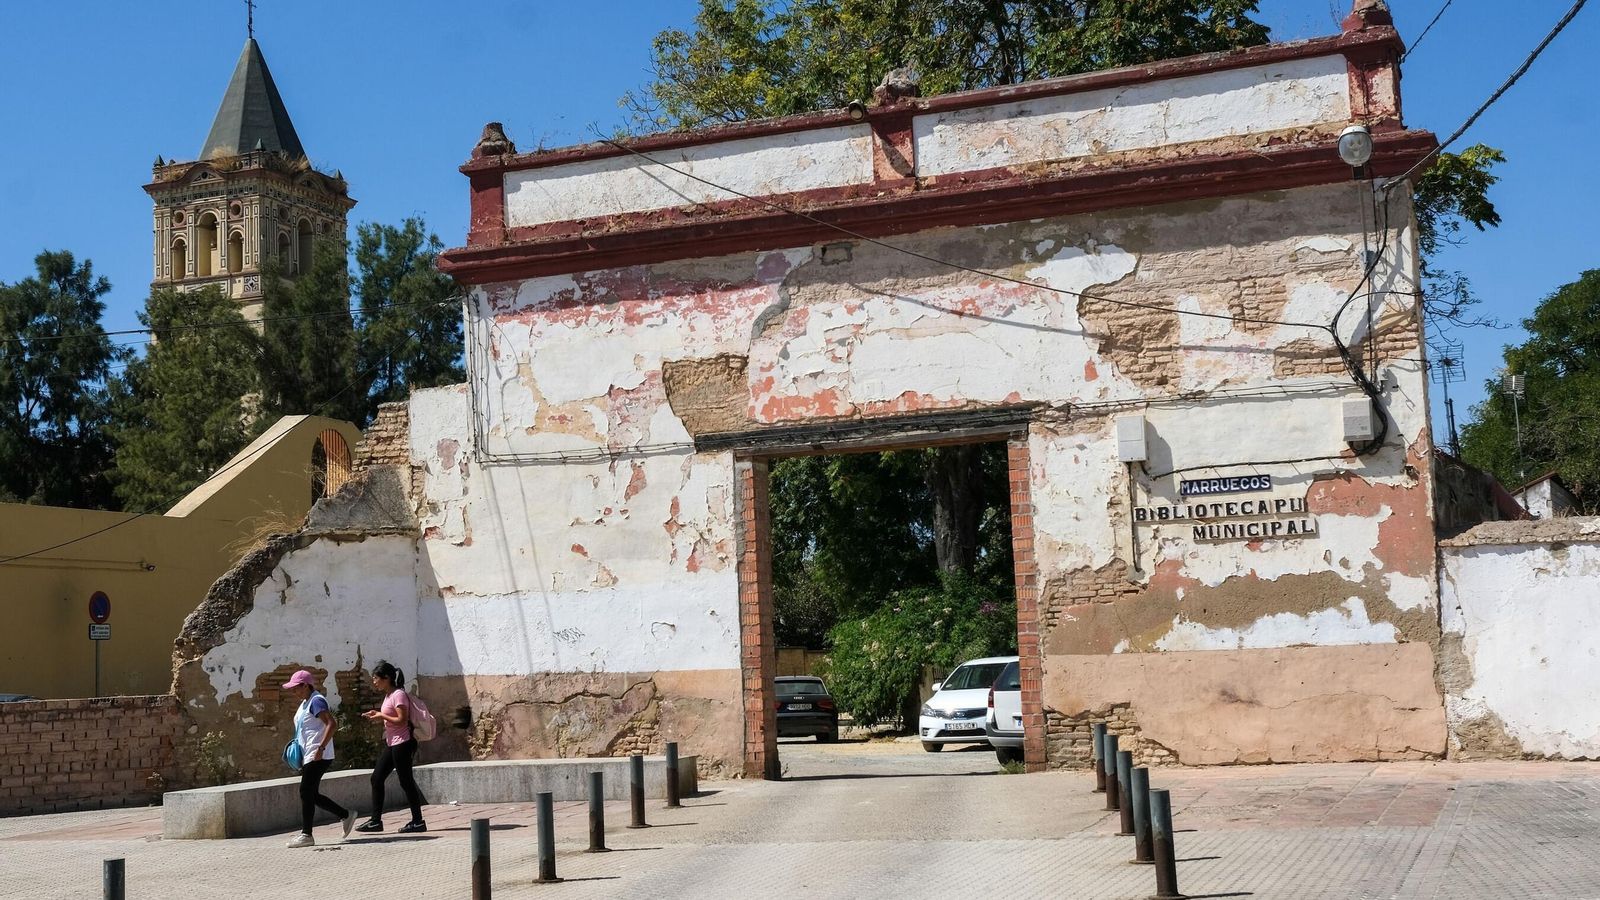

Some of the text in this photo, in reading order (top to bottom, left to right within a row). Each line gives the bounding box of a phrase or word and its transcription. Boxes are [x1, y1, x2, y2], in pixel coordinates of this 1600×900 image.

[1181, 476, 1270, 495] MARRUECOS
[1135, 500, 1269, 521] BIBLIOTECA
[1193, 520, 1314, 540] MUNICIPAL
